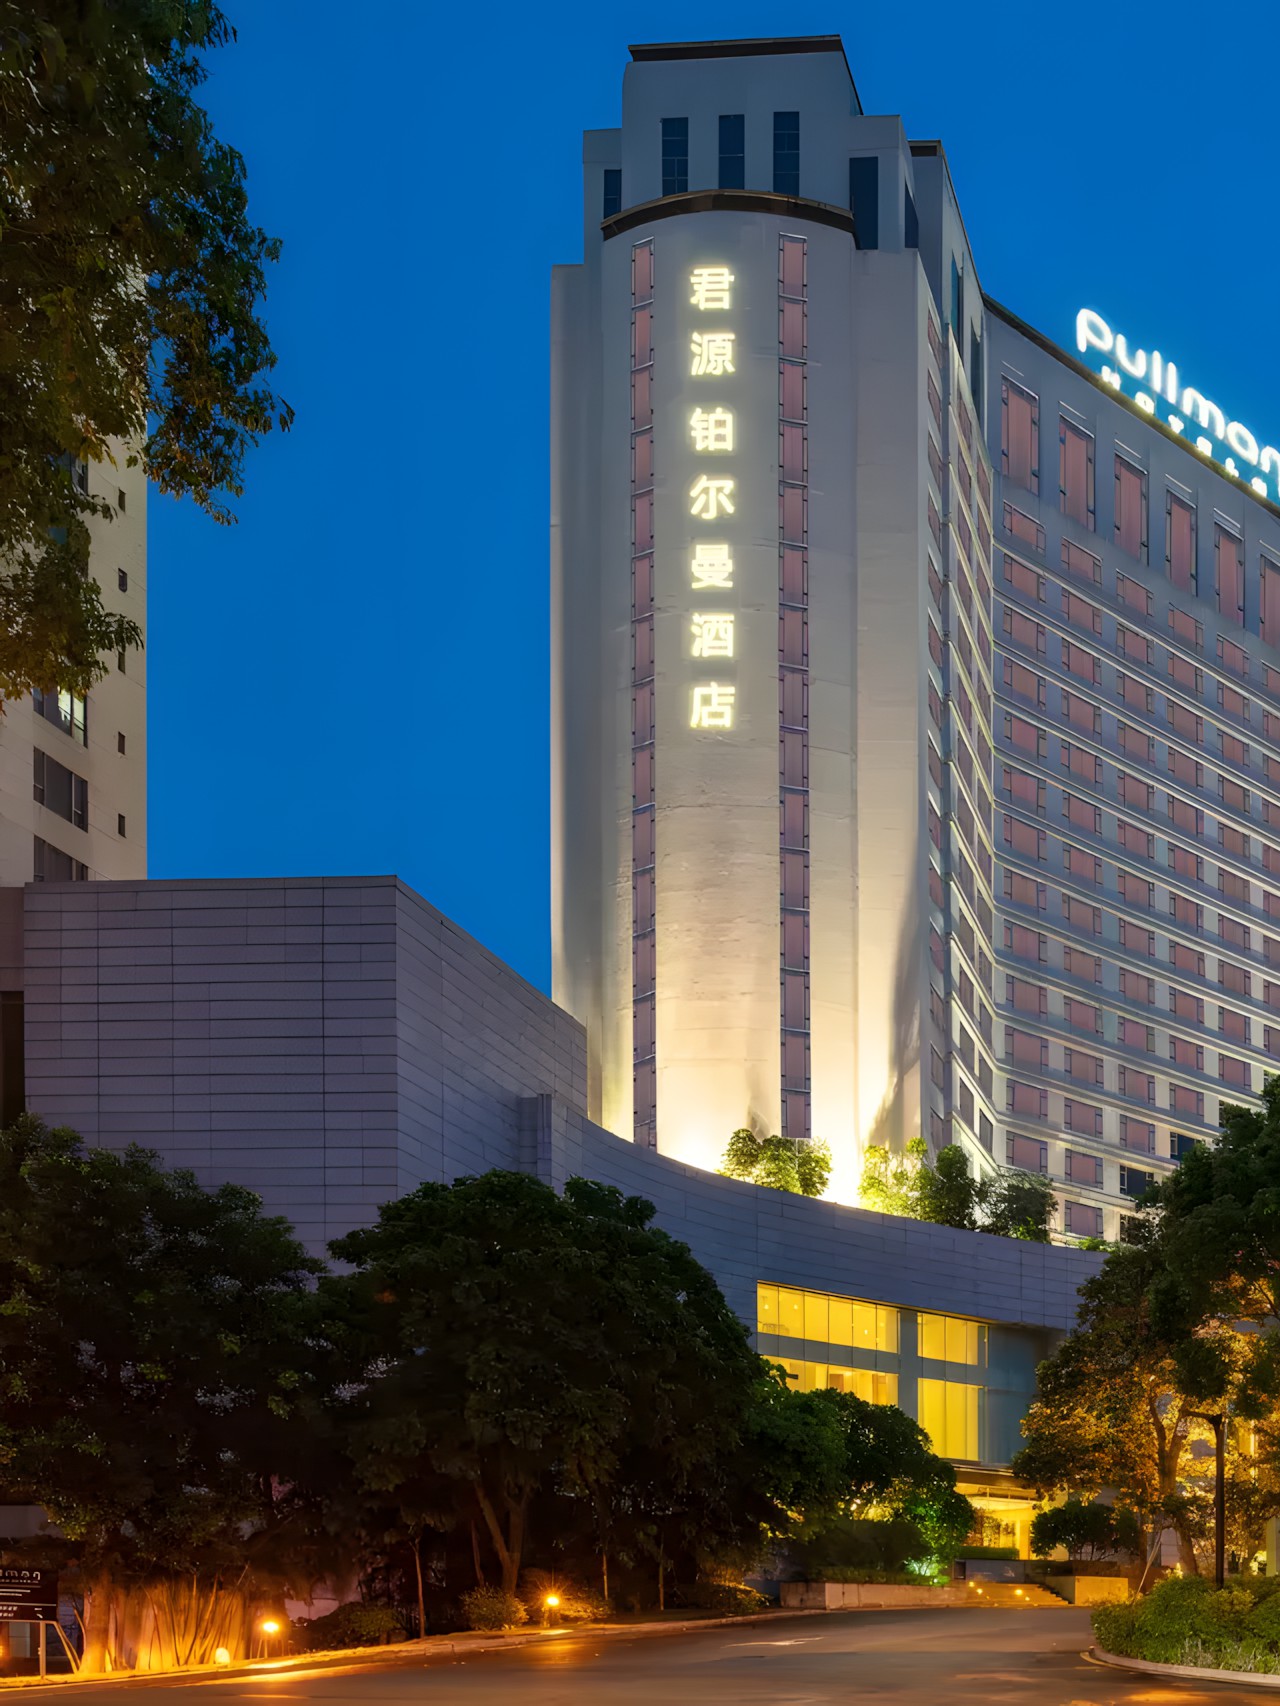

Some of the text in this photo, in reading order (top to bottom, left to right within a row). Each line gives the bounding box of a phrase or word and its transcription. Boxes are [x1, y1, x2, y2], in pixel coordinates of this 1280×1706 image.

[689, 266, 736, 729] 君源铂尔曼酒店
